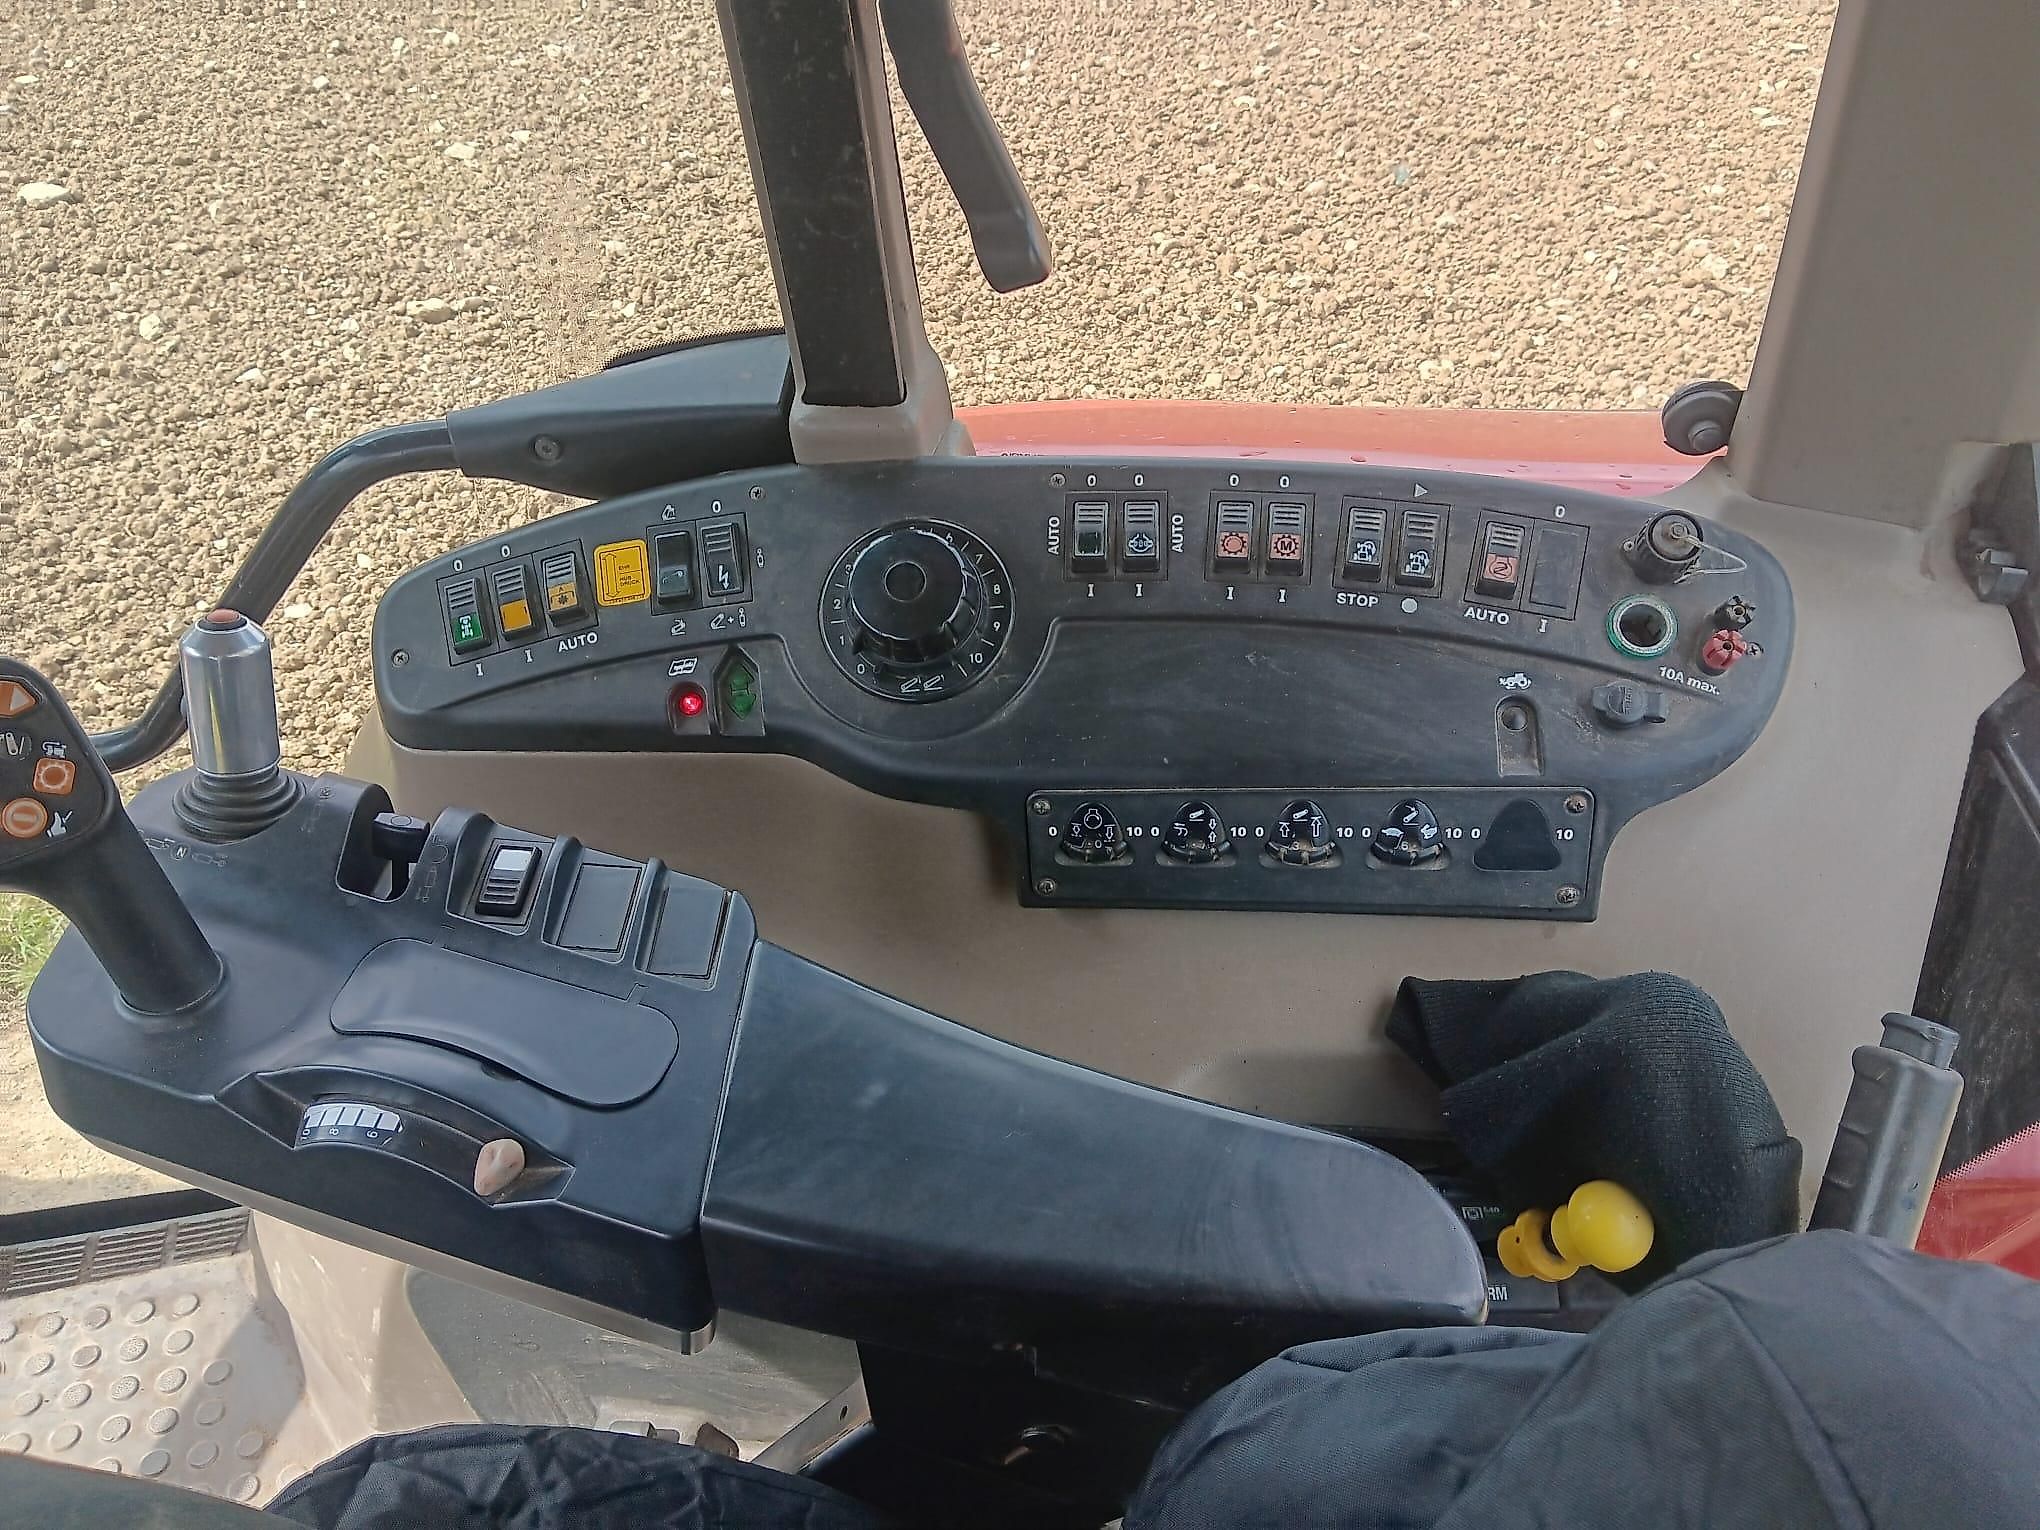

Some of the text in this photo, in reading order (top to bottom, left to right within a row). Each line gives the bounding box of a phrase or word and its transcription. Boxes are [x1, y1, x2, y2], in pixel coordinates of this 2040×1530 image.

[1087, 475, 1096, 487] 0
[1134, 475, 1143, 487] 0
[1230, 474, 1239, 487] 0
[1279, 476, 1290, 488] 0
[712, 501, 721, 513] 0
[1555, 506, 1565, 518] 0
[1048, 516, 1060, 555] AUTO
[1172, 514, 1184, 553] AUTO
[501, 545, 510, 557] 0
[976, 554, 984, 564] 7
[453, 560, 463, 572] 0
[993, 584, 1001, 594] 8
[833, 599, 842, 609] 2
[1336, 592, 1379, 608] STOP
[1464, 607, 1510, 625] AUTO
[993, 622, 1001, 632] 9
[559, 632, 598, 652] AUTO
[839, 635, 845, 645] 1
[969, 653, 983, 663] 10
[857, 664, 866, 674] 0
[1659, 665, 1720, 695] 10A max.
[1049, 826, 1057, 836] 0
[1126, 826, 1143, 837] 10
[1150, 826, 1160, 837] 0
[1230, 826, 1247, 837] 10
[1255, 826, 1264, 837] 0
[1336, 827, 1353, 838] 10
[1361, 827, 1371, 838] 0
[1445, 828, 1462, 839] 10
[1471, 828, 1480, 839] 0
[1556, 829, 1573, 840] 10
